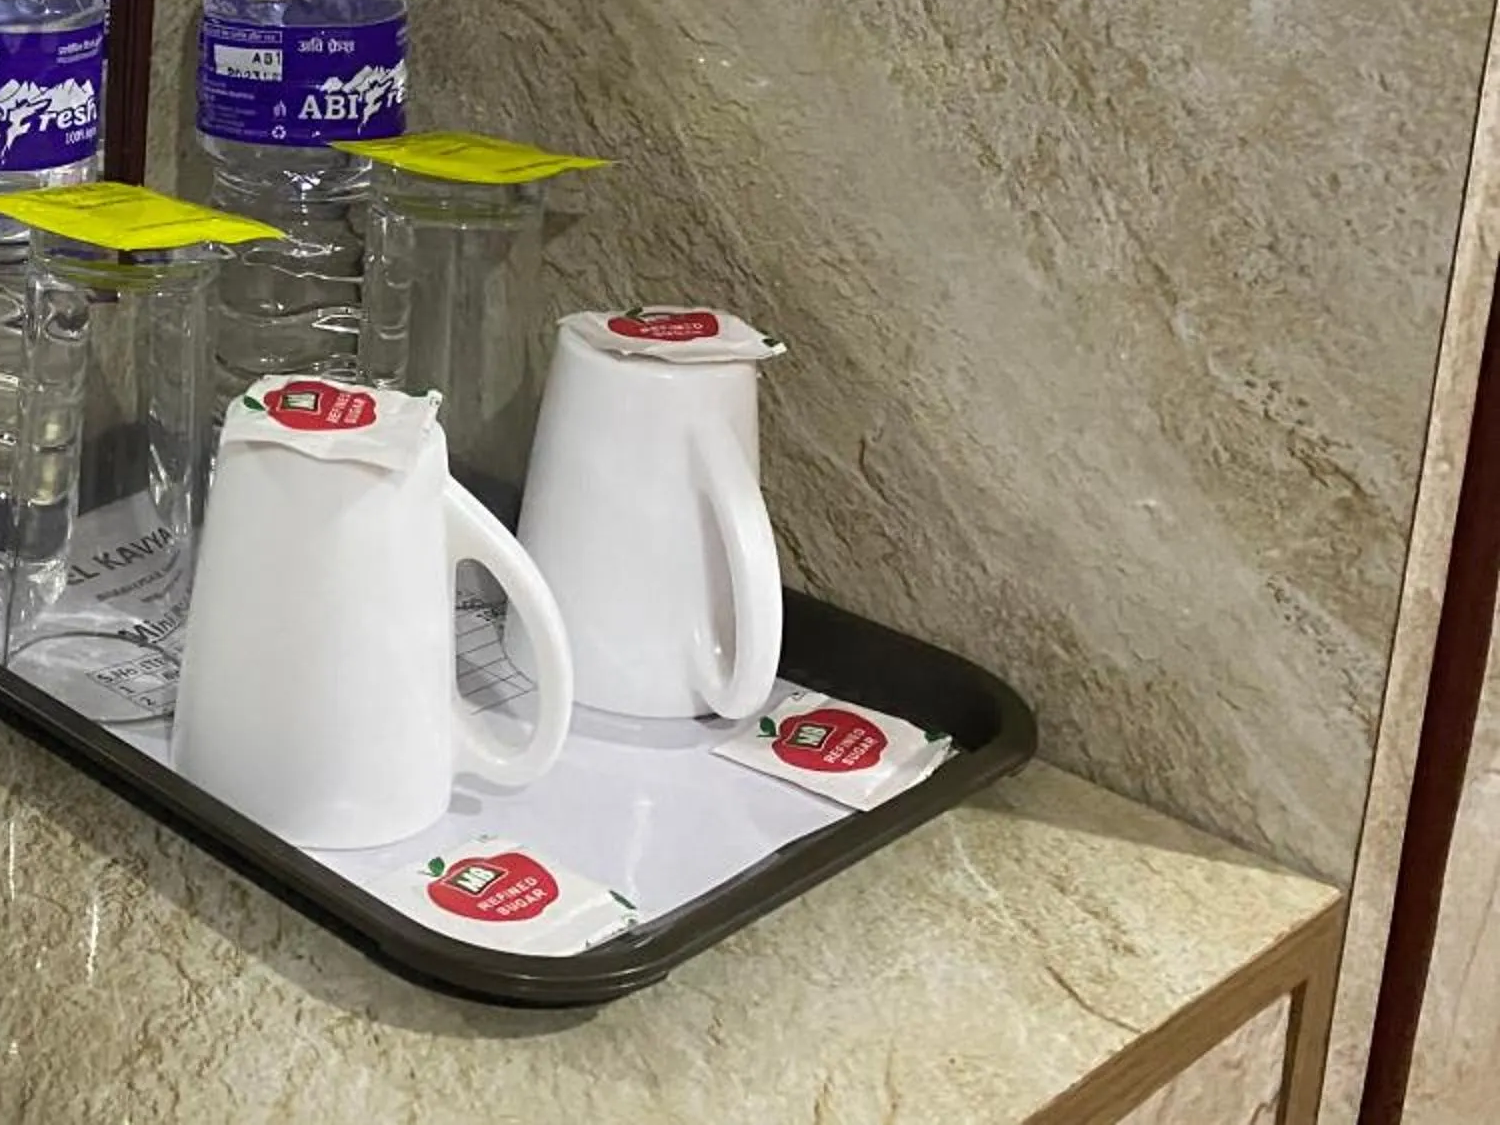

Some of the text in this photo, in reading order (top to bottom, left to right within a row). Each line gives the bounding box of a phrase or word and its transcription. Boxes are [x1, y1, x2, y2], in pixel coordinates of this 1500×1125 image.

[298, 94, 358, 119] ABI
[92, 527, 172, 571] KAVYA
[476, 876, 538, 911] REFINED
[496, 888, 548, 916] SUGAR
